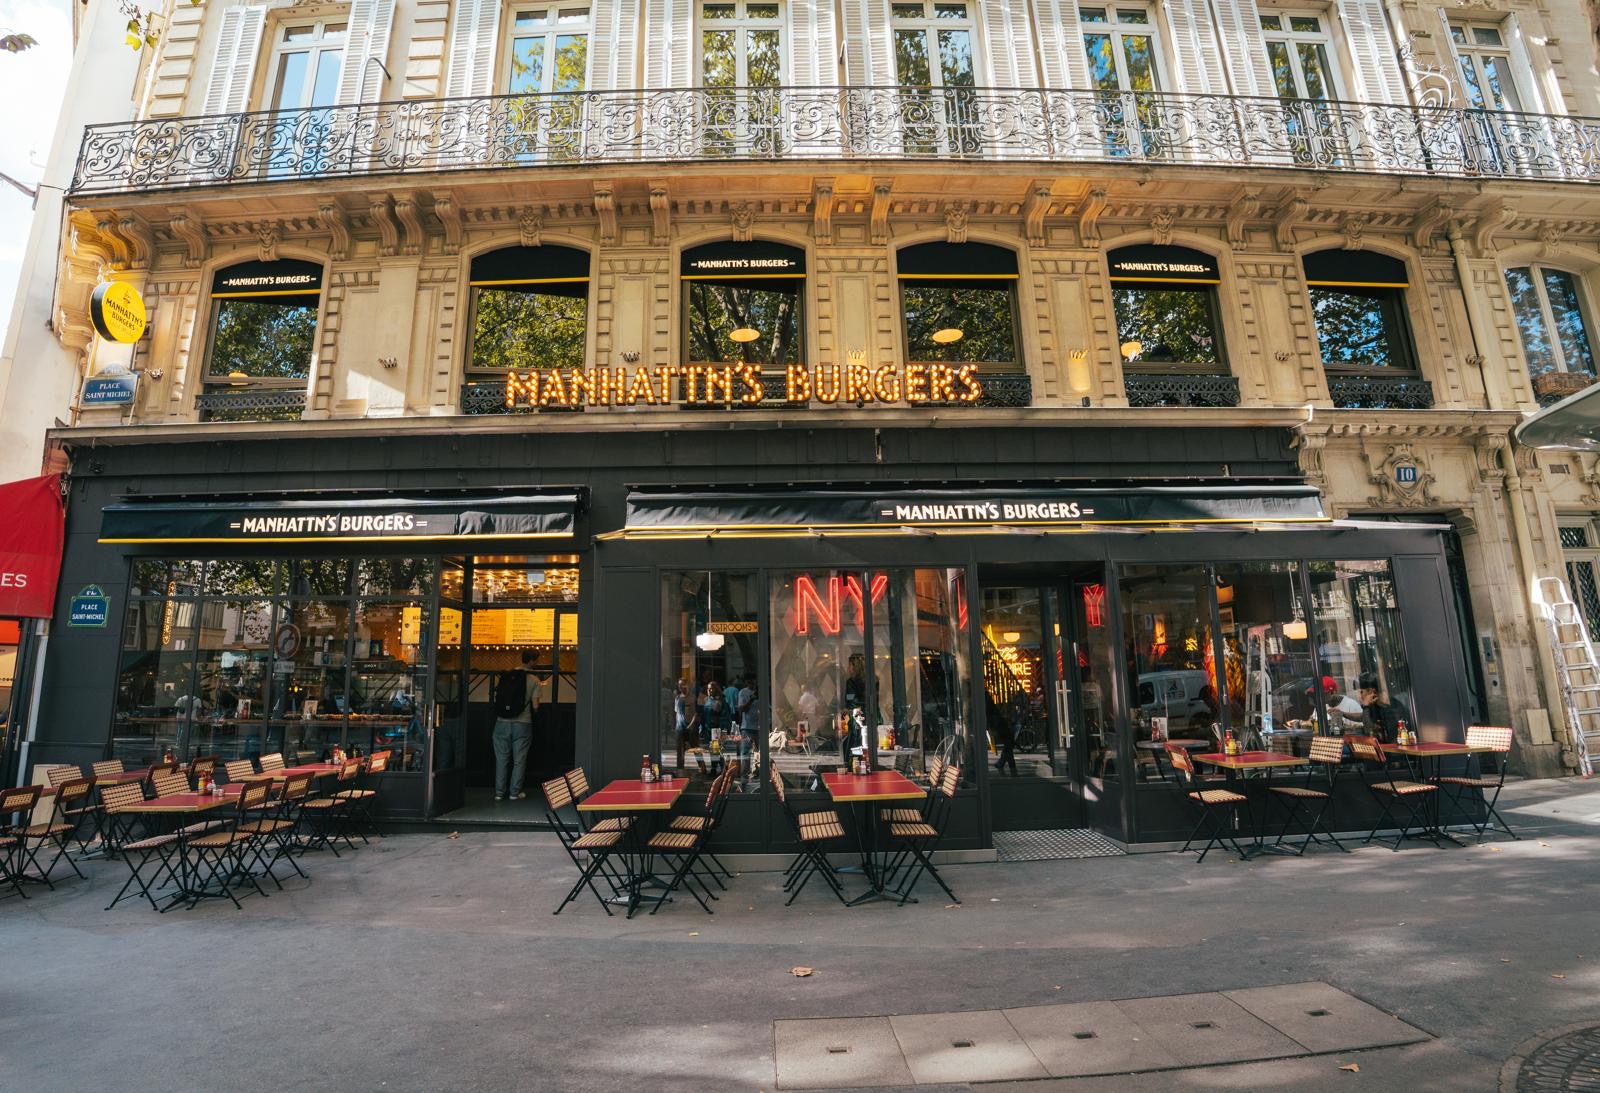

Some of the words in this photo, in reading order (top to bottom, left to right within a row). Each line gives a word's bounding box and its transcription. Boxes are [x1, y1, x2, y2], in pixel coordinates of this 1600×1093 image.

[698, 259, 749, 268] MANHATTN'S
[750, 259, 789, 268] BURGERS
[1121, 262, 1168, 271] MANHATTN'S
[1169, 264, 1204, 272] BURGERS
[229, 276, 274, 286] MANHATTN'S
[275, 275, 310, 284] BURGERS
[505, 360, 764, 407] MANHATTN'S
[785, 363, 983, 404] BURGERS
[84, 391, 106, 399] SAINT
[1400, 468, 1414, 481] 10
[895, 501, 1000, 521] MANHATTN'S
[1003, 502, 1082, 520] BURGERS
[242, 514, 338, 533] MANHATTN'S
[340, 514, 414, 531] BURGERS
[0, 572, 28, 588] ES
